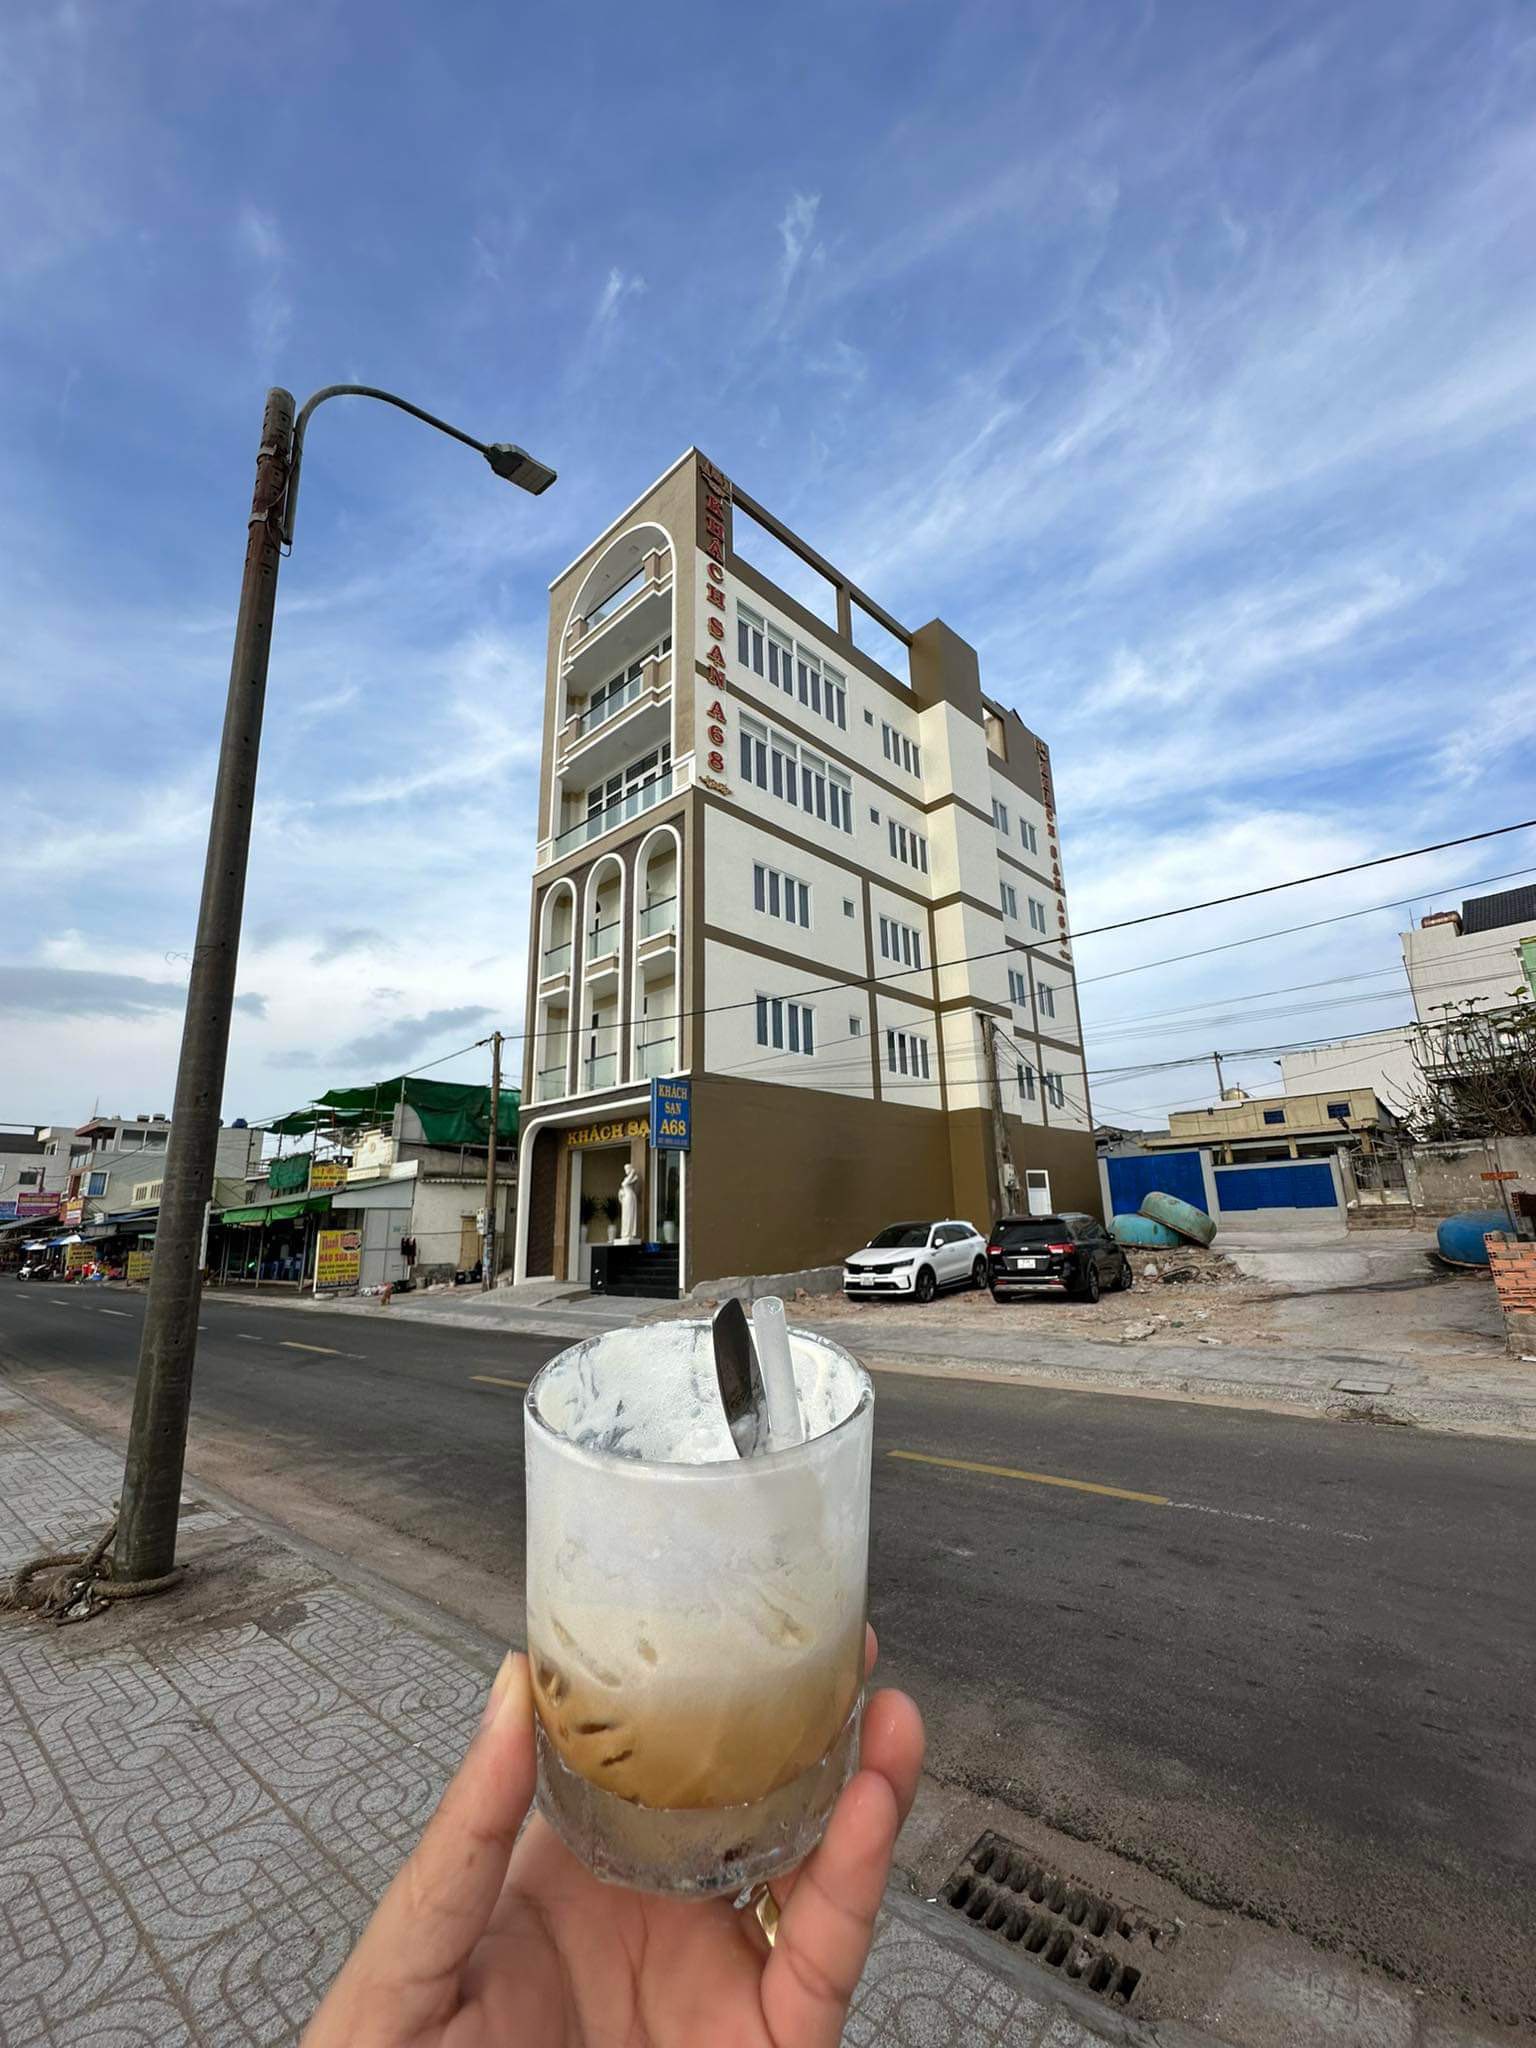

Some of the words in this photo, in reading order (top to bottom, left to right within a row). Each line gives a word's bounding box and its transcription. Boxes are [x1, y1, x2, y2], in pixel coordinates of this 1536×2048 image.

[706, 495, 725, 612] KHÁCH
[706, 616, 726, 691] SẠN
[706, 700, 727, 774] A68
[658, 1083, 687, 1099] KHÁCH
[665, 1101, 681, 1116] SẠN
[568, 1122, 624, 1144] KHÁCH
[627, 1119, 651, 1138] SẠ
[660, 1119, 686, 1136] A68
